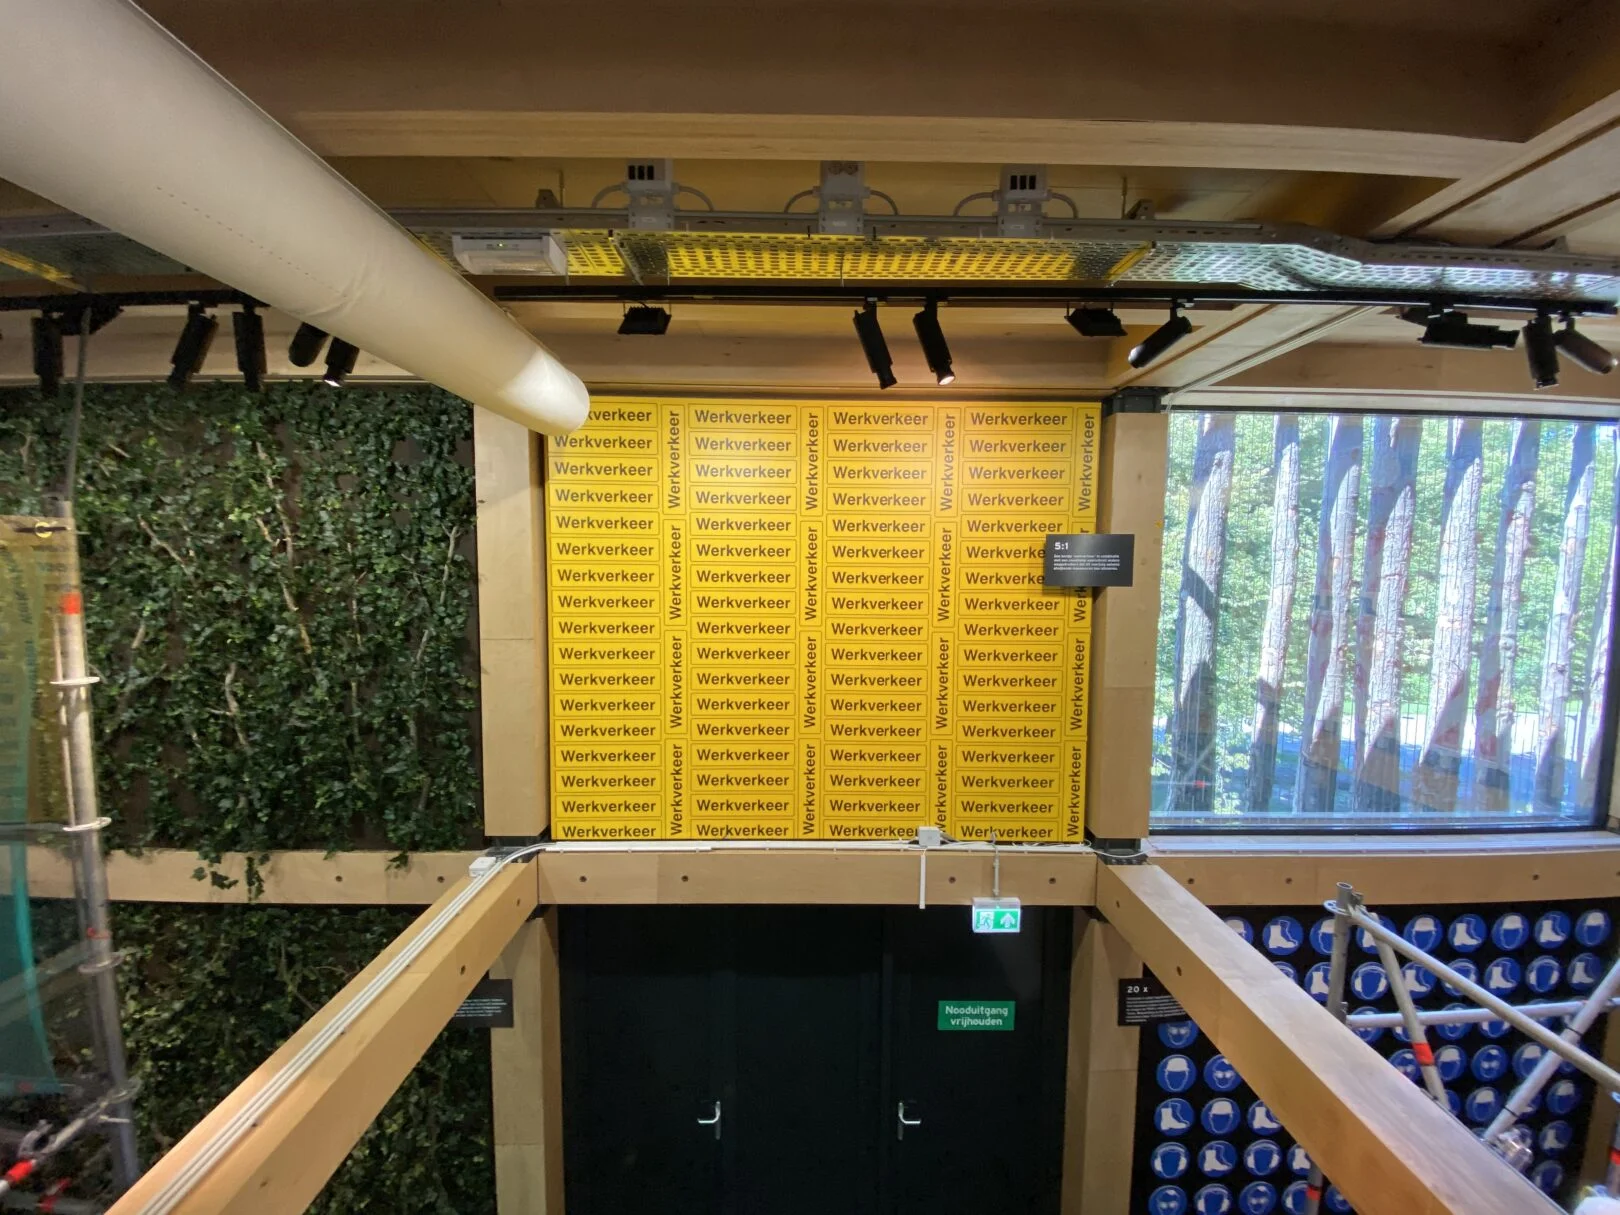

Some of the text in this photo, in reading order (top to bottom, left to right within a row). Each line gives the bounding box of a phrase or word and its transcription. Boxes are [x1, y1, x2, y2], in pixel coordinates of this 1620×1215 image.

[588, 408, 652, 422] verkeer
[694, 410, 792, 424] Werkverkeer
[833, 412, 928, 426] Werkverkeer
[971, 412, 1068, 426] Werkverkeer
[554, 434, 652, 449] Werkverkeer
[695, 437, 792, 452] Werkverkeer
[833, 439, 927, 452] Werkverkeer
[970, 440, 1066, 453] Werkverkeer
[666, 410, 680, 509] Werkverkeer
[805, 412, 819, 511] Werkverkeer
[940, 414, 955, 511] Werkverkeer
[1078, 414, 1095, 512] Werkverkeer
[554, 462, 653, 476] Werkverkeer
[695, 464, 792, 478] Werkverkeer
[833, 466, 926, 480] Werkverkeer
[968, 466, 1065, 480] Werkverkeer
[555, 489, 654, 503] Werkverkeer
[696, 491, 792, 505] Werkverkeer
[832, 492, 926, 506] Werkverkeer
[968, 493, 1064, 506] Werkverkeer
[556, 516, 654, 530] Werkverkeer
[696, 517, 792, 532] Werkverkeer
[832, 519, 926, 533] Werkverkeer
[967, 520, 1063, 533] Werkverkeer
[556, 542, 654, 556] Werkverkeer
[696, 544, 791, 558] Werkverkeer
[832, 545, 925, 559] Werkverkeer
[966, 546, 1046, 559] Werkverke
[1054, 541, 1069, 550] 5:1
[557, 569, 655, 583] Werkverkeer
[668, 524, 682, 620] Werkverkeer
[696, 570, 791, 584] Werkverkeer
[804, 526, 818, 621] Werkverkeer
[832, 571, 924, 585] Werkverkeer
[937, 527, 952, 622] Werkverkeer
[965, 572, 1045, 585] Werkverke
[557, 595, 655, 608] Werkverkeer
[696, 596, 791, 609] Werkverkeer
[831, 597, 924, 611] Werkverkeer
[964, 598, 1060, 611] Werkverkeer
[558, 621, 655, 634] Werkverkeer
[696, 621, 791, 635] Werkverkeer
[831, 622, 924, 636] Werkverkeer
[964, 623, 1059, 636] Werkverkeer
[558, 647, 656, 660] Werkverkeer
[696, 647, 790, 660] Werkverkeer
[831, 648, 923, 662] Werkverkeer
[963, 649, 1058, 662] Werkverkeer
[559, 672, 656, 686] Werkverkeer
[669, 636, 683, 729] Werkverkeer
[696, 672, 790, 686] Werkverkeer
[804, 636, 817, 728] Werkverkeer
[830, 673, 922, 687] Werkverkeer
[935, 637, 949, 730] Werkverkeer
[963, 674, 1057, 688] Werkverkeer
[1070, 638, 1085, 731] Werkverkeer
[560, 698, 656, 712] Werkverkeer
[696, 698, 790, 711] Werkverkeer
[830, 698, 922, 712] Werkverkeer
[962, 700, 1056, 713] Werkverkeer
[560, 724, 656, 737] Werkverkeer
[696, 723, 790, 736] Werkverkeer
[830, 724, 922, 737] Werkverkeer
[962, 725, 1056, 738] Werkverkeer
[560, 749, 656, 762] Werkverkeer
[696, 748, 790, 761] Werkverkeer
[830, 749, 922, 762] Werkverkeer
[961, 750, 1055, 764] Werkverkeer
[560, 774, 656, 788] Werkverkeer
[696, 774, 790, 787] Werkverkeer
[829, 774, 921, 787] Werkverkeer
[961, 776, 1054, 788] Werkverkeer
[670, 744, 683, 836] Werkverkeer
[802, 744, 816, 835] Werkverkeer
[1067, 746, 1082, 837] Werkverkeer
[562, 800, 656, 813] Werkverkeer
[696, 799, 790, 812] Werkverkeer
[829, 799, 921, 812] Werkverkeer
[961, 800, 1054, 814] Werkverkeer
[562, 825, 656, 838] Werkverkeer
[696, 824, 789, 837] Werkverkeer
[945, 1005, 1009, 1017] Nooduitgang
[950, 1017, 1003, 1028] vrijhouden
